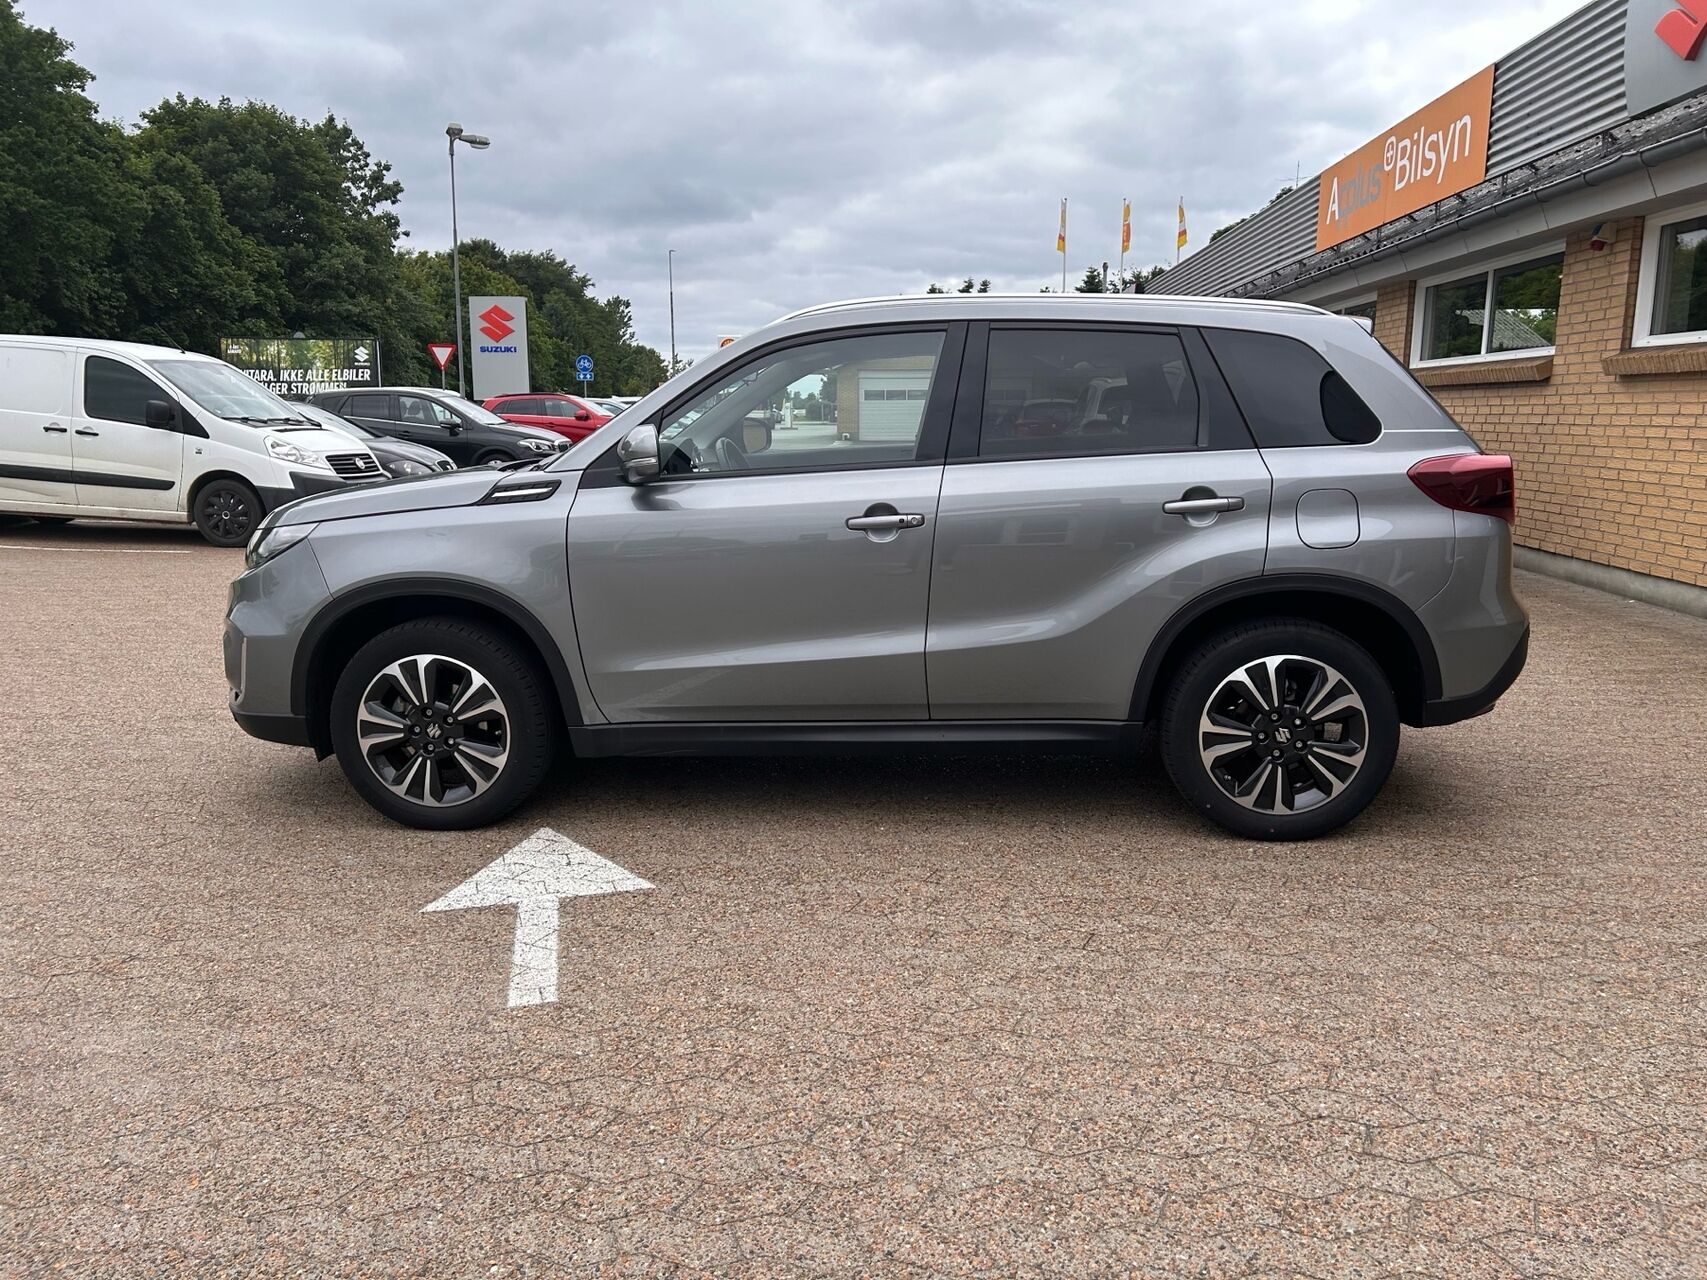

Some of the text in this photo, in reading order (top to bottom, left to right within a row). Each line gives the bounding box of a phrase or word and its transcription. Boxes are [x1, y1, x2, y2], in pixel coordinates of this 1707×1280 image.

[1394, 114, 1472, 192] Bilsyn
[279, 369, 304, 381] IKKE
[305, 368, 331, 381] ALLE
[331, 368, 371, 381] ELBILER
